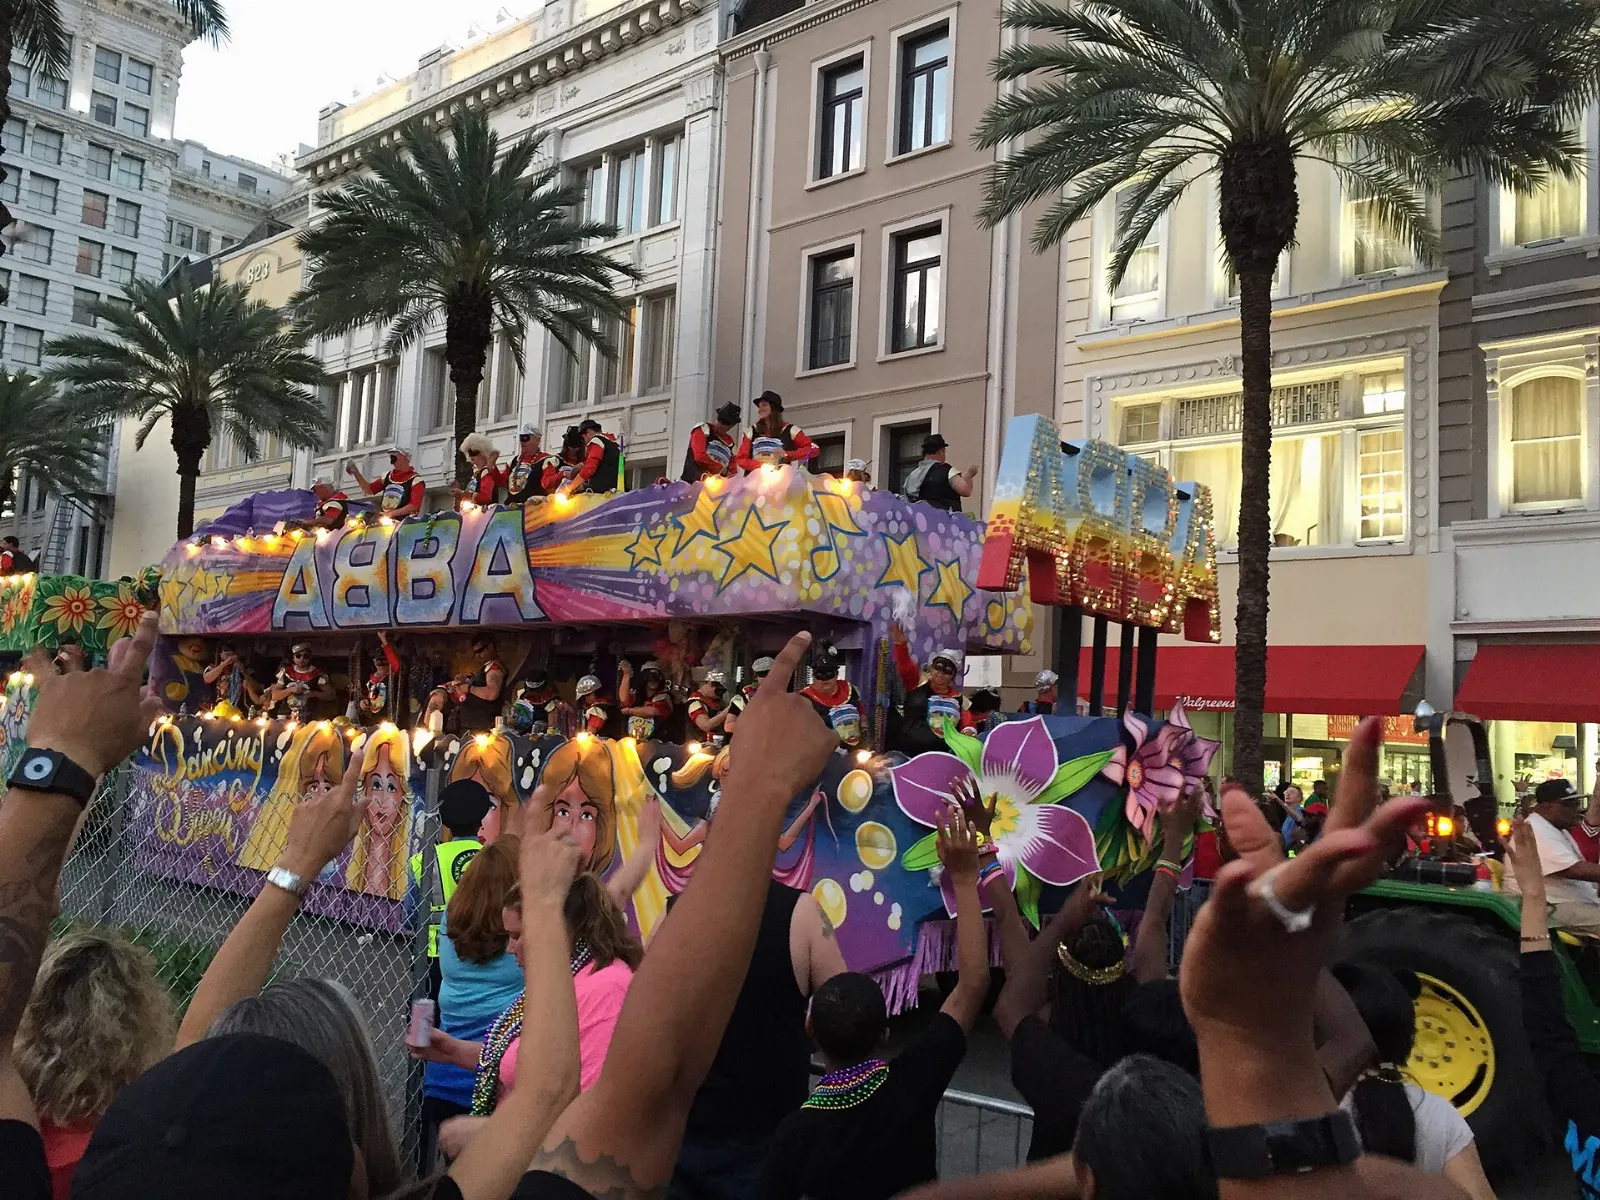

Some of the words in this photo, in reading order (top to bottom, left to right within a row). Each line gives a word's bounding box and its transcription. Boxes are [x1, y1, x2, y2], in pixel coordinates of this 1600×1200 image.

[247, 260, 270, 284] 823
[271, 504, 552, 631] ABBA
[976, 413, 1221, 644] ABBA
[1175, 695, 1236, 711] Walgreens
[151, 714, 265, 812] Dancing
